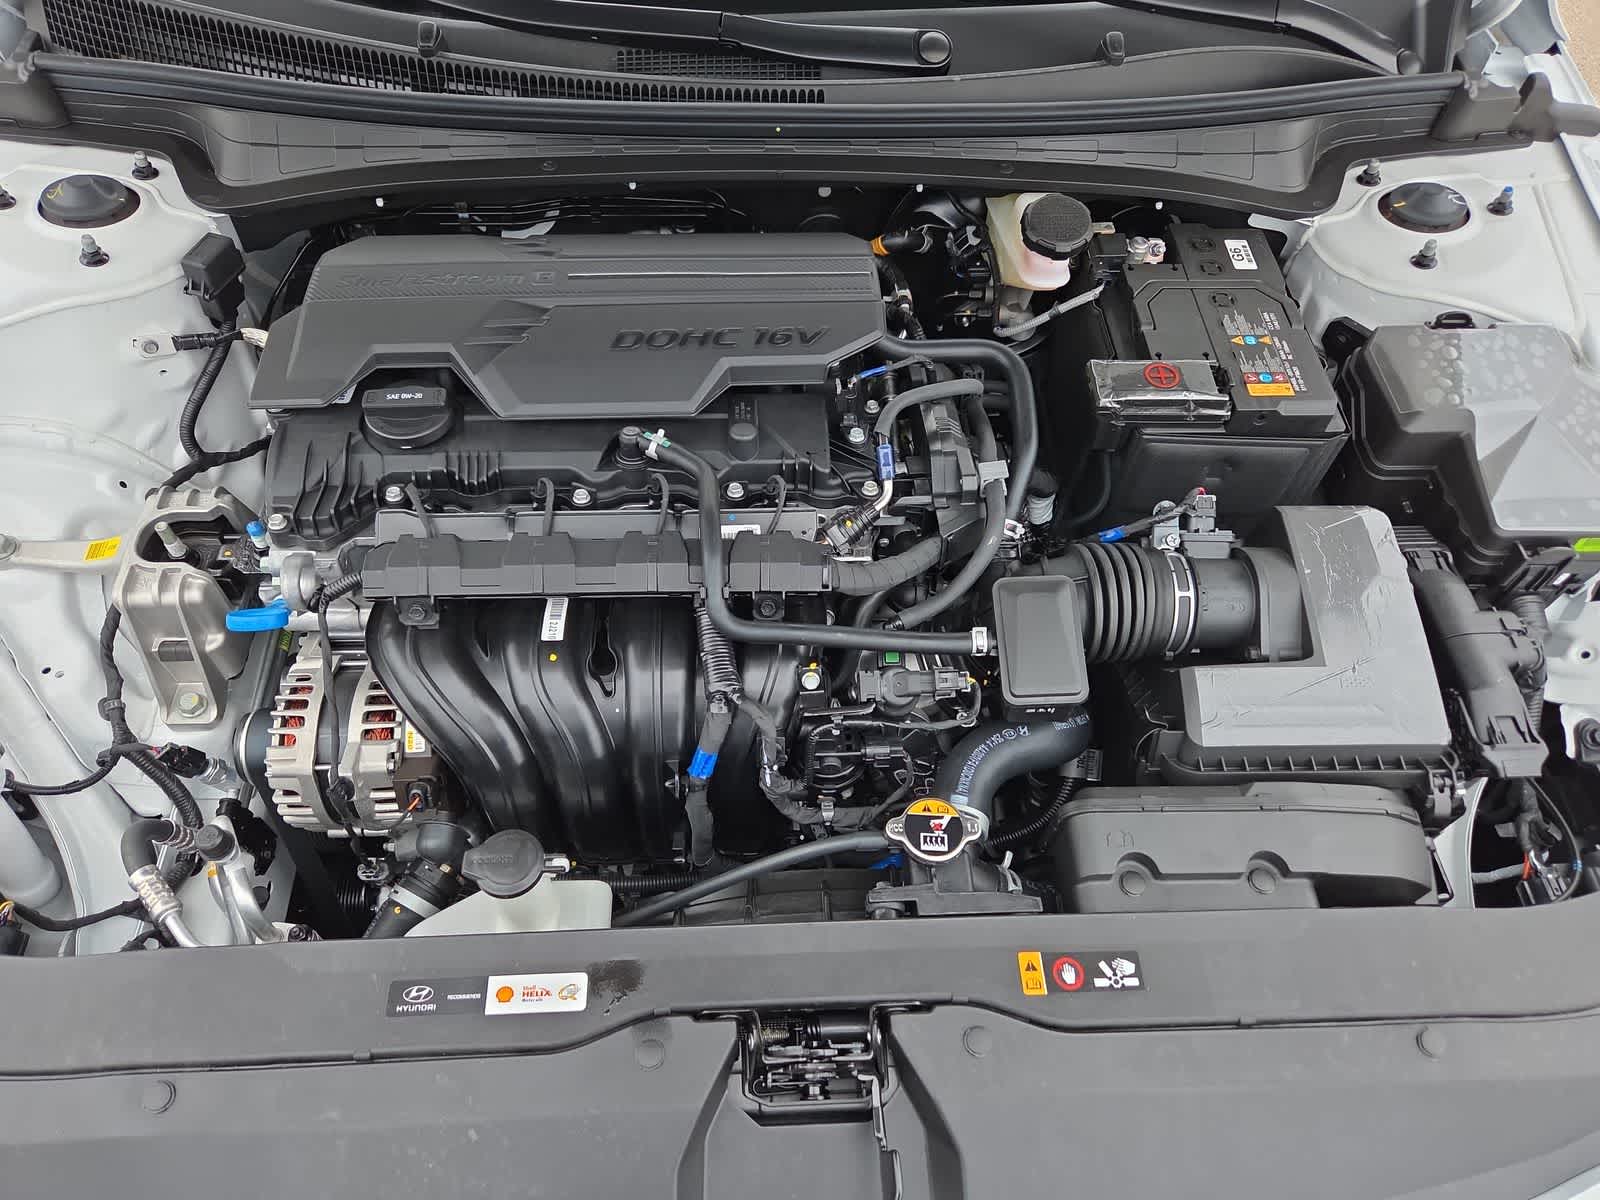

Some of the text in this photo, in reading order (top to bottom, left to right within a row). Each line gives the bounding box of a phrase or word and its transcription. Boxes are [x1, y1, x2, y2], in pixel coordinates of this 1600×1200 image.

[1229, 247, 1245, 262] G6
[608, 324, 830, 350] DOHC 16V
[522, 990, 551, 998] HELIX
[396, 1004, 437, 1013] HYUNDAI
